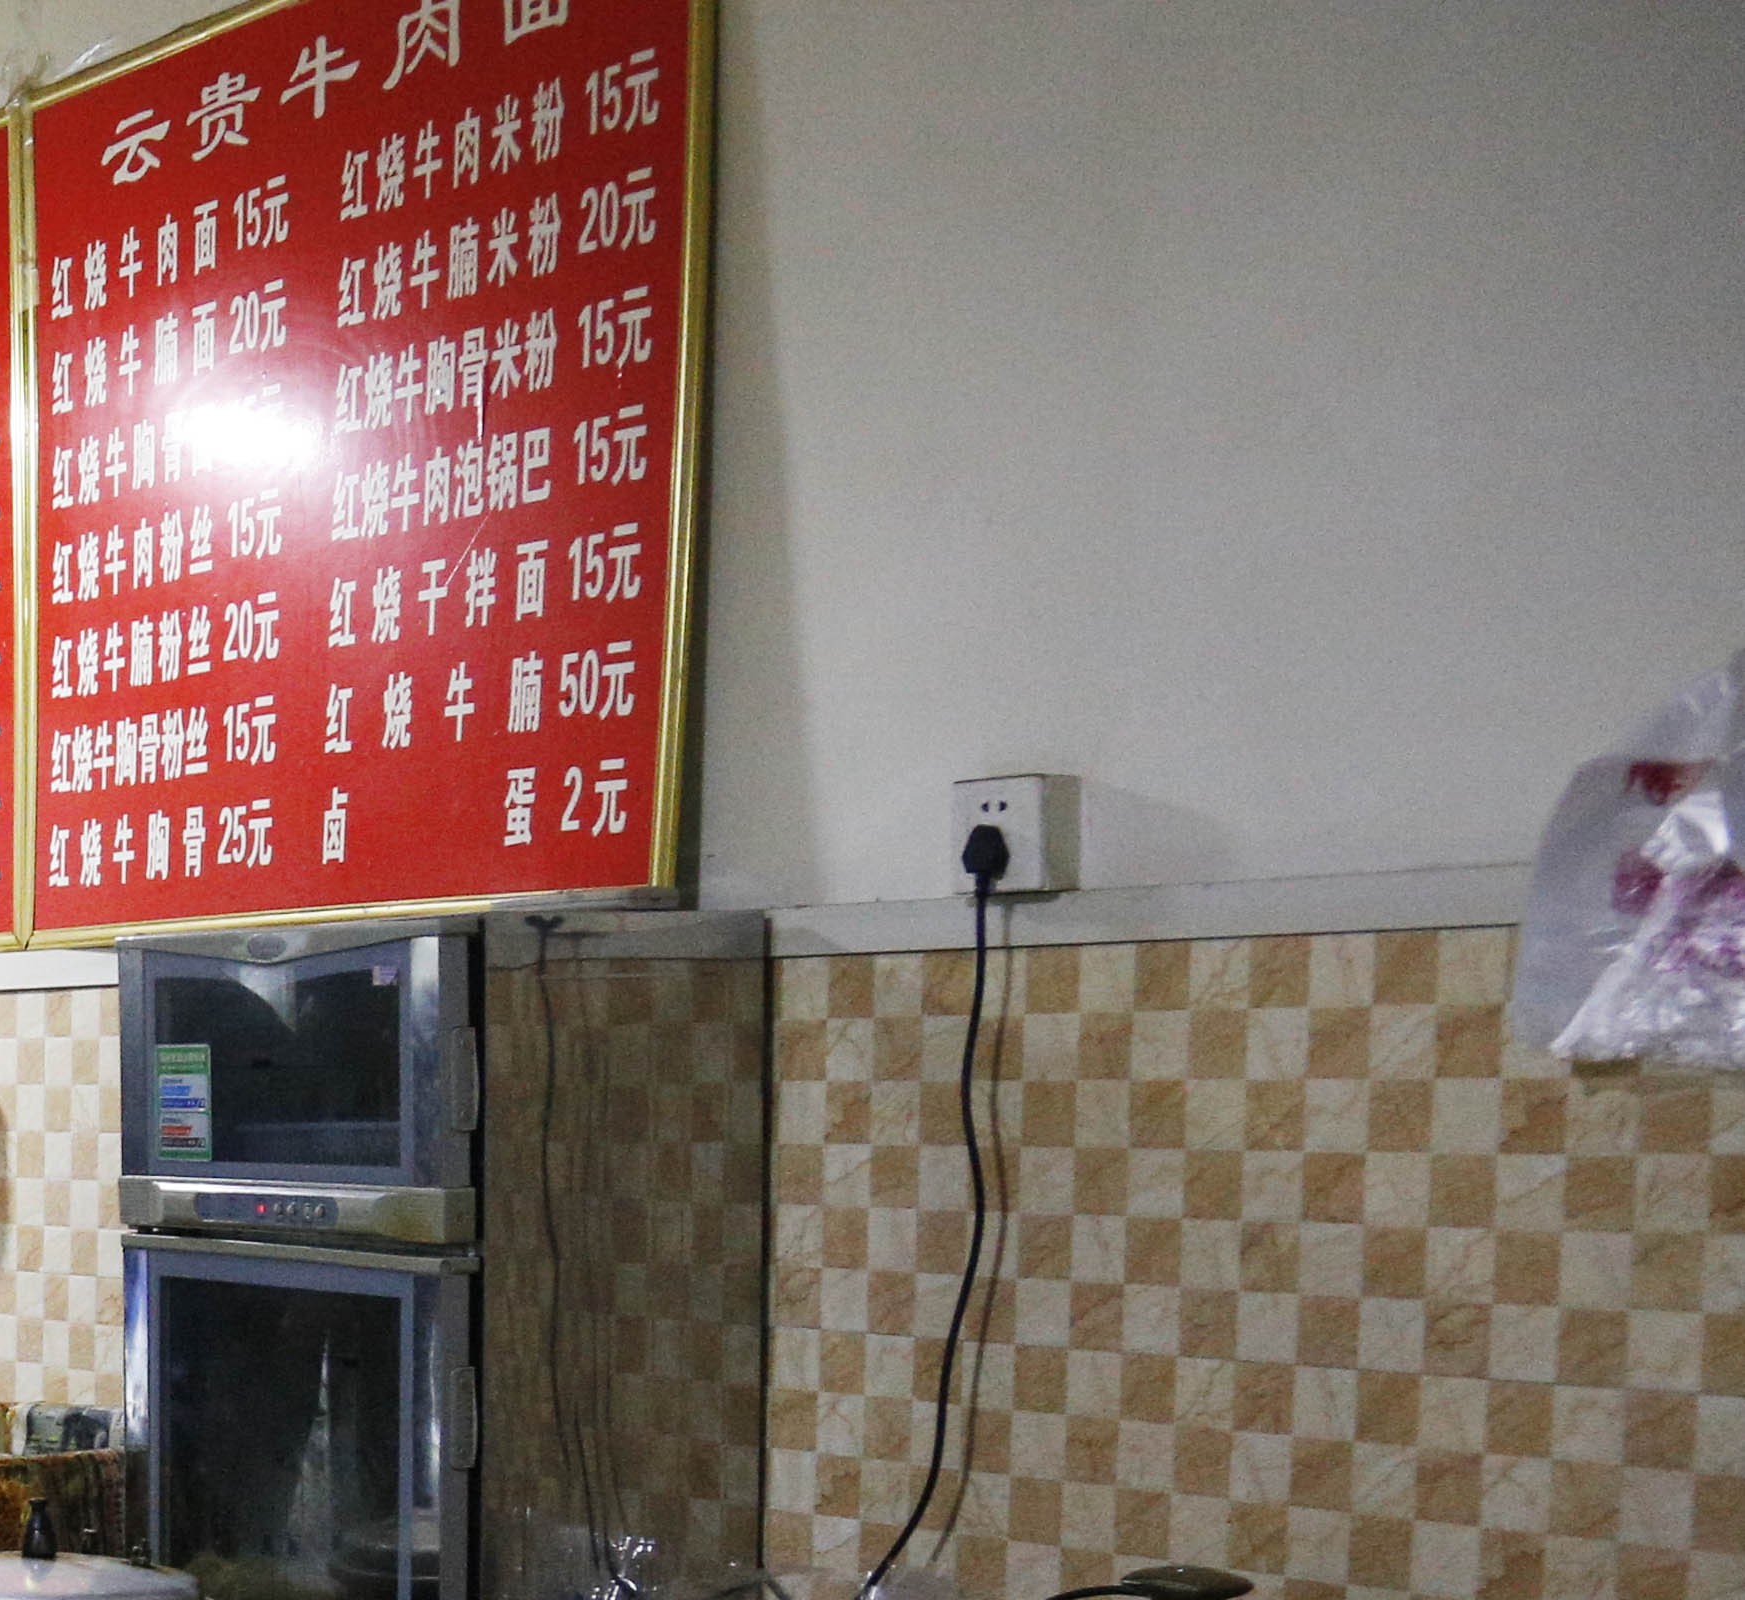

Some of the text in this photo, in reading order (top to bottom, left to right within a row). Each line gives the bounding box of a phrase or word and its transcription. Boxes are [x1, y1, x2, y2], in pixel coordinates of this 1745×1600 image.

[340, 47, 660, 221] 红烧牛肉米粉 15元
[50, 174, 289, 320] 红烧牛肉面 15元
[337, 166, 656, 328] 红烧牛腩米粉 20元
[51, 279, 288, 415] 红烧牛腩面 20元
[334, 308, 558, 436] 红烧牛胸骨米粉
[578, 286, 652, 369] 15元
[52, 402, 212, 510] 红烧牛胸骨
[331, 427, 551, 541] 红烧牛肉泡锅巴
[573, 404, 648, 486] 15元
[52, 489, 282, 604] 红烧牛肉粉丝 15元
[328, 522, 642, 648] 红烧干拌面 15元
[52, 591, 279, 698] 红烧牛腩粉丝 20元
[324, 640, 636, 754] 红烧牛腩 50元
[50, 695, 276, 793] 红烧牛胸骨粉丝 15元
[561, 758, 628, 837] 2元
[49, 798, 273, 887] 红烧牛胸骨 25元
